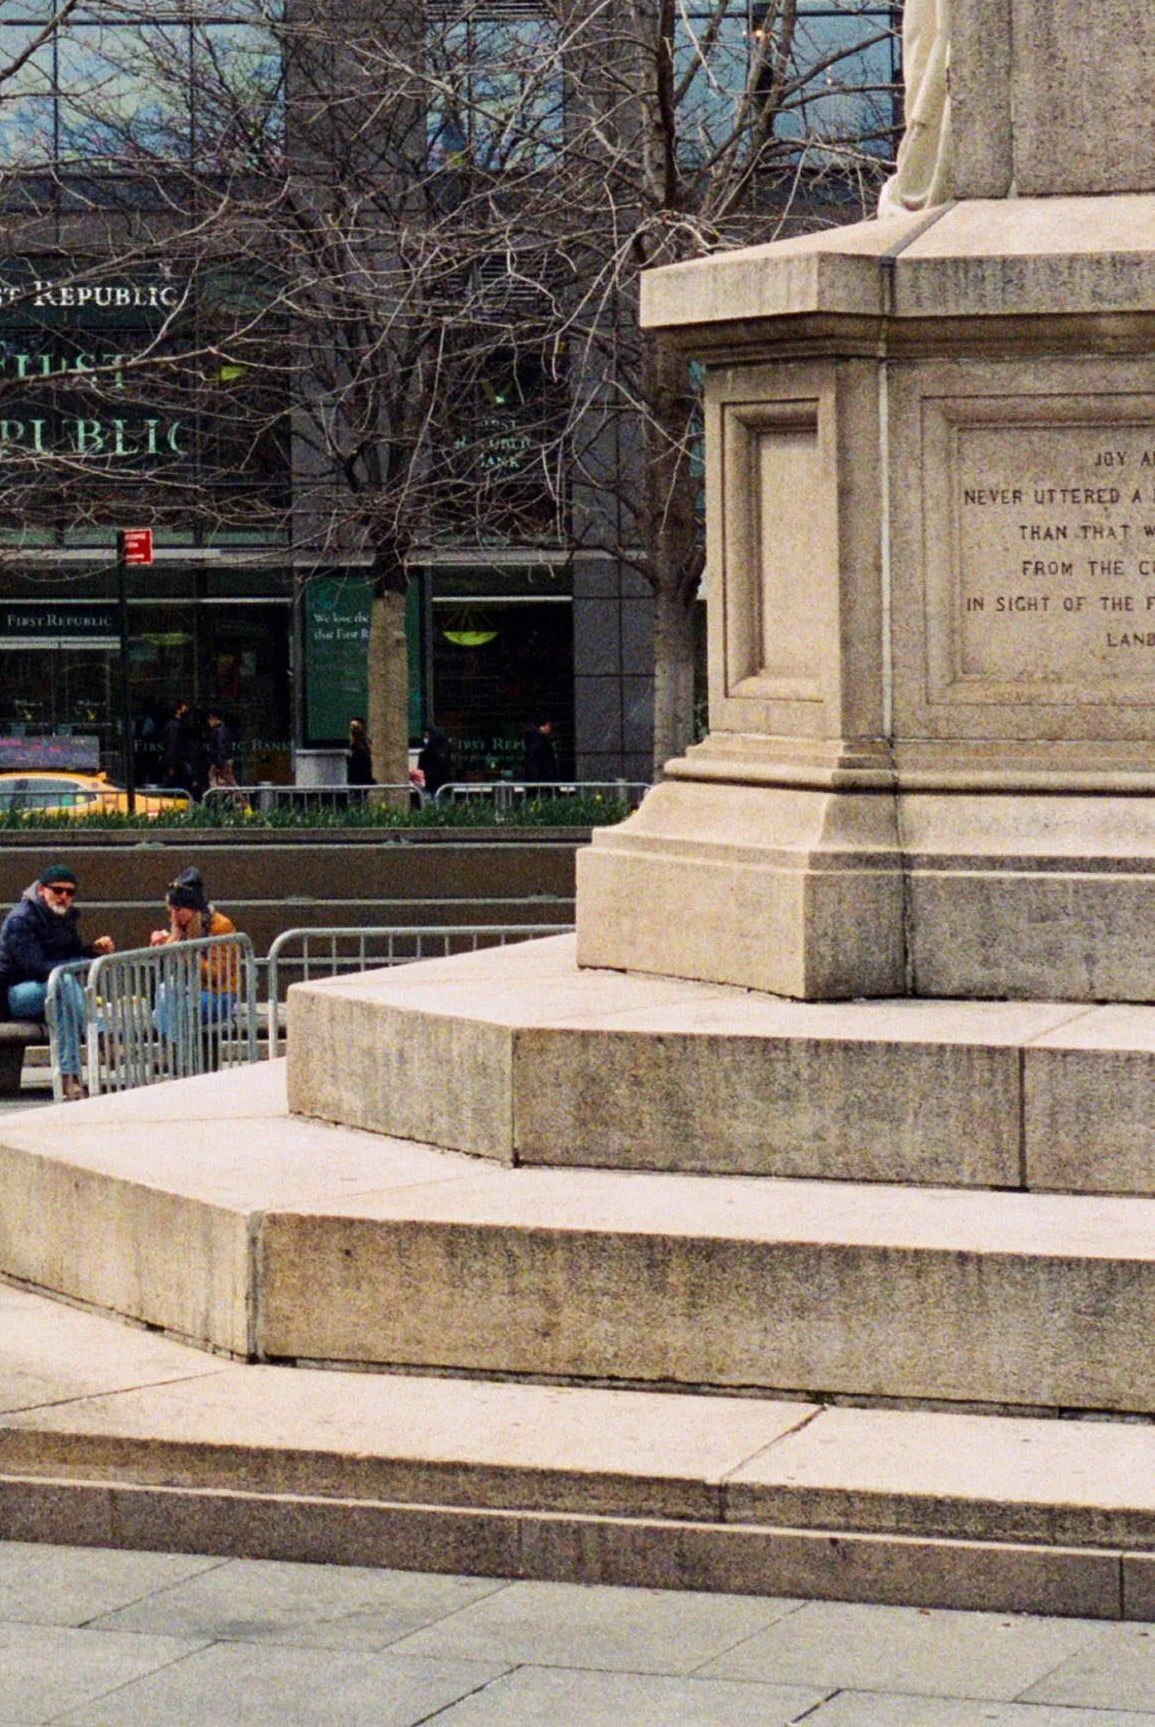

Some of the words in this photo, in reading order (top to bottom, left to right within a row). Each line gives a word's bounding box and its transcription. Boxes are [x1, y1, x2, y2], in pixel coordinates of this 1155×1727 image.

[33, 280, 180, 306] REPUBLIC
[1094, 451, 1128, 467] JOY
[1140, 451, 1155, 467] A
[963, 489, 1023, 505] NEVER
[1033, 488, 1121, 505] UTTERED
[1131, 489, 1143, 504] A
[1019, 524, 1068, 540] THAN
[1079, 524, 1131, 540] THAT
[1022, 560, 1074, 576] FROM
[1088, 560, 1125, 575] THE
[1138, 560, 1155, 575] C
[966, 597, 985, 612] IN
[996, 596, 1050, 612] SIGHT
[1062, 596, 1087, 612] OF
[1099, 596, 1135, 612] THE
[7, 614, 43, 627] FIRST
[46, 613, 113, 627] REPUBLIC
[133, 738, 165, 752] FIRS
